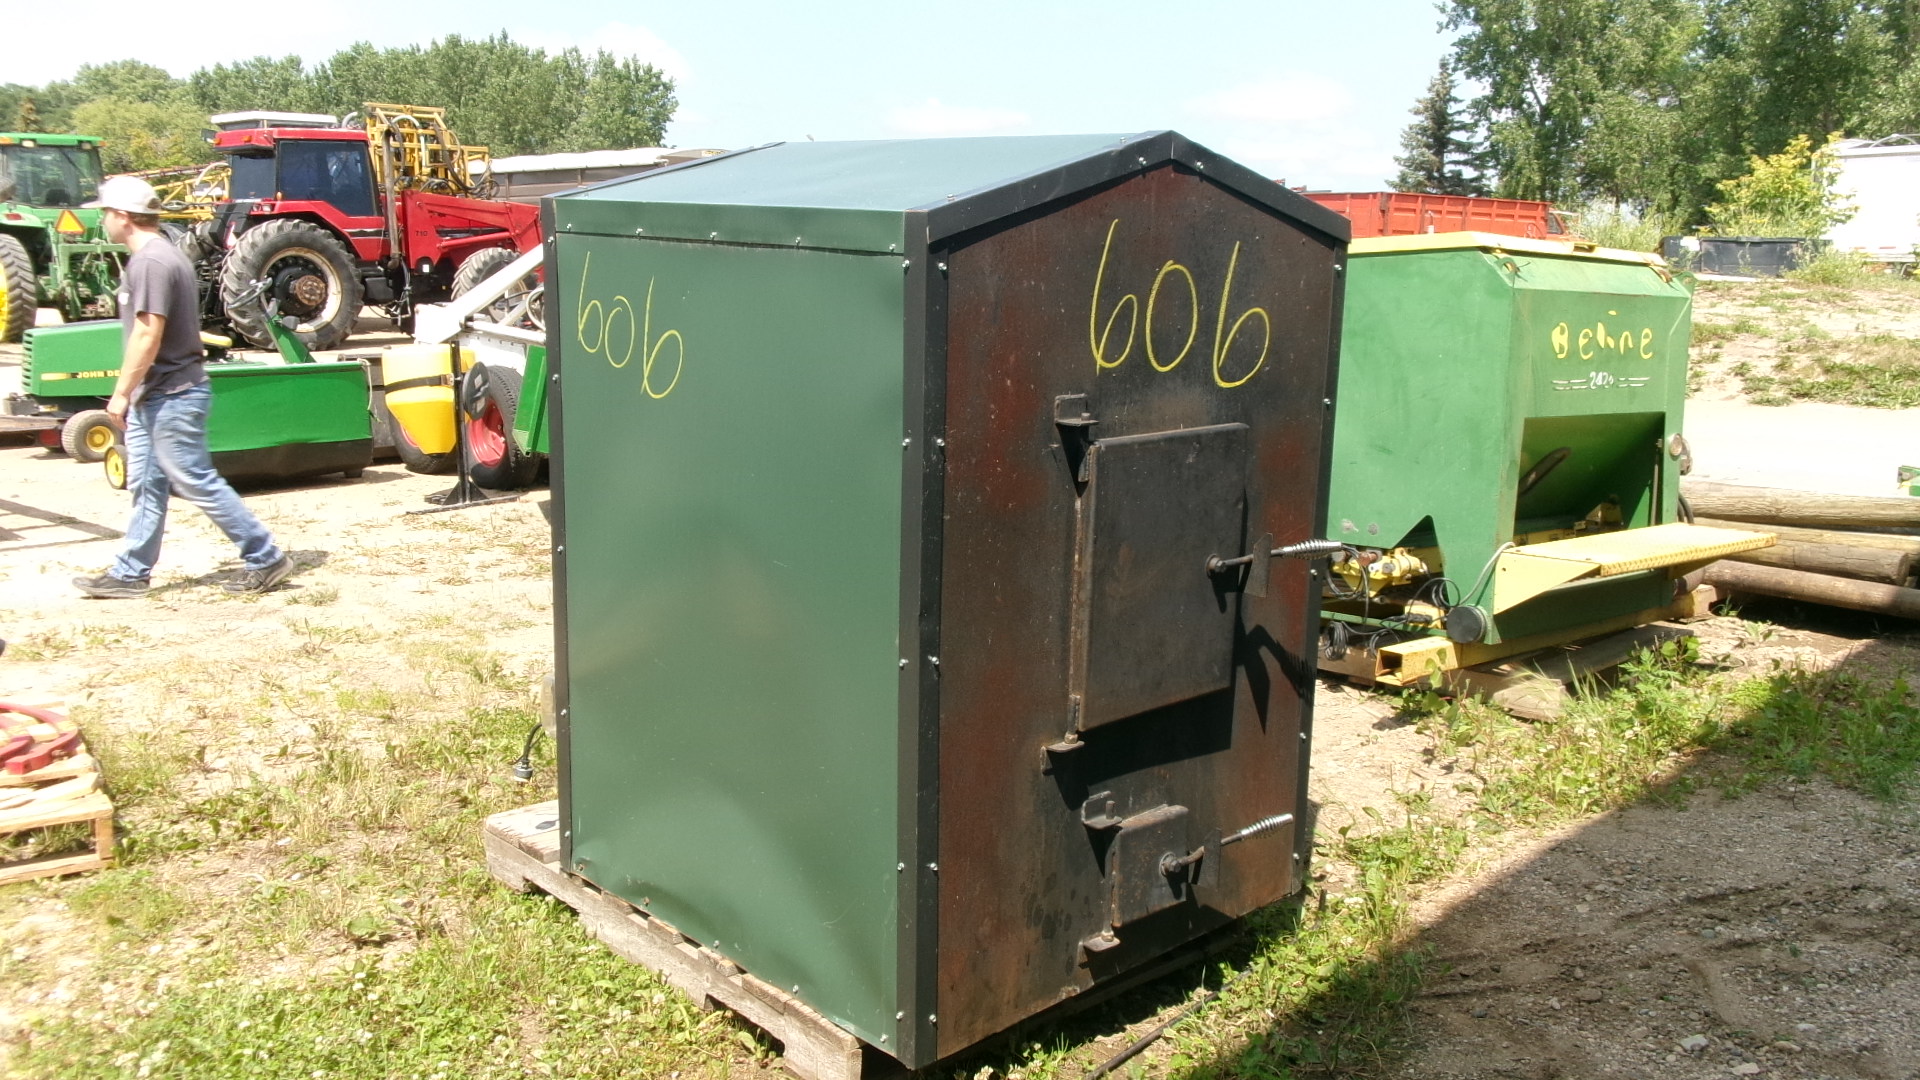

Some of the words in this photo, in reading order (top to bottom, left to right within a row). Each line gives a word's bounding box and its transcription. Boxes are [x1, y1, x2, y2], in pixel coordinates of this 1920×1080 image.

[76, 370, 105, 379] JOHN
[577, 250, 683, 399] 606
[1090, 218, 1270, 388] 606
